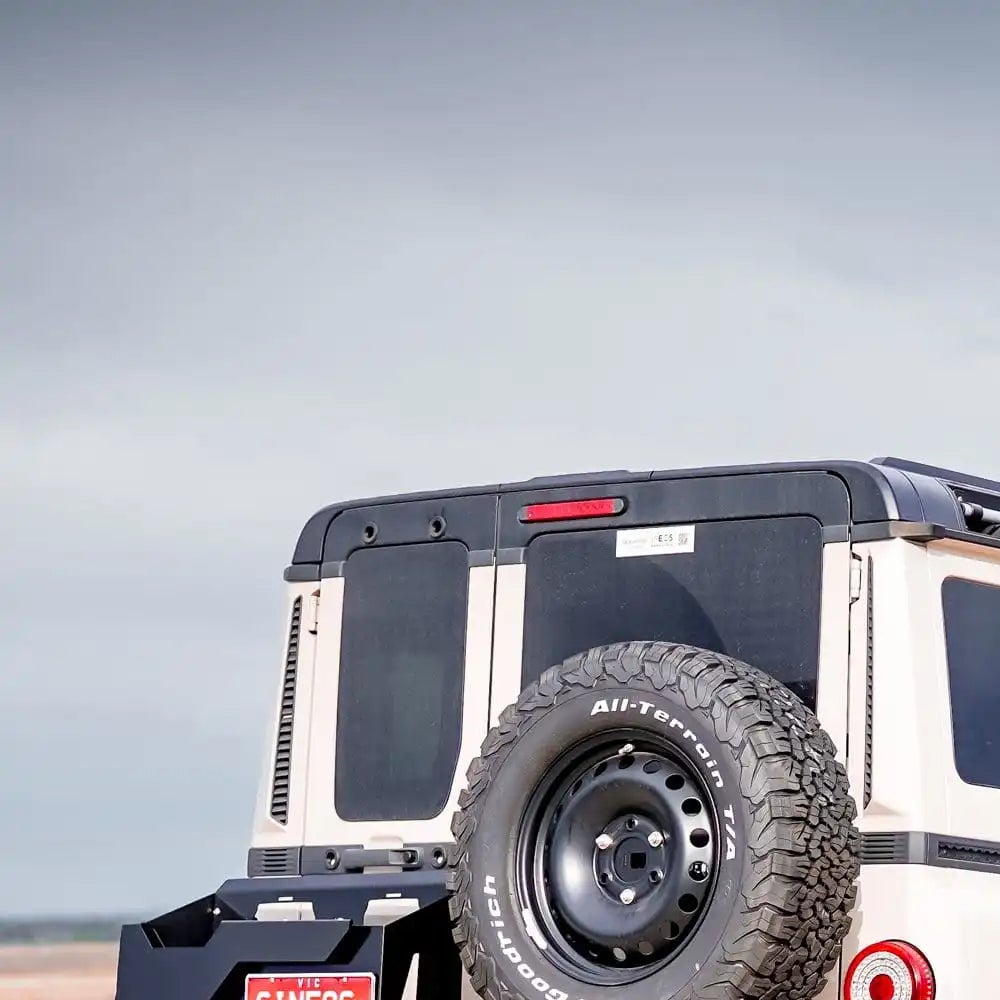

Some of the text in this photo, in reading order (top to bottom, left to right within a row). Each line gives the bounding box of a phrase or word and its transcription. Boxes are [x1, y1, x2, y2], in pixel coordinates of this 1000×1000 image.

[591, 698, 736, 860] All-Terrain T/A
[297, 978, 320, 988] VIC
